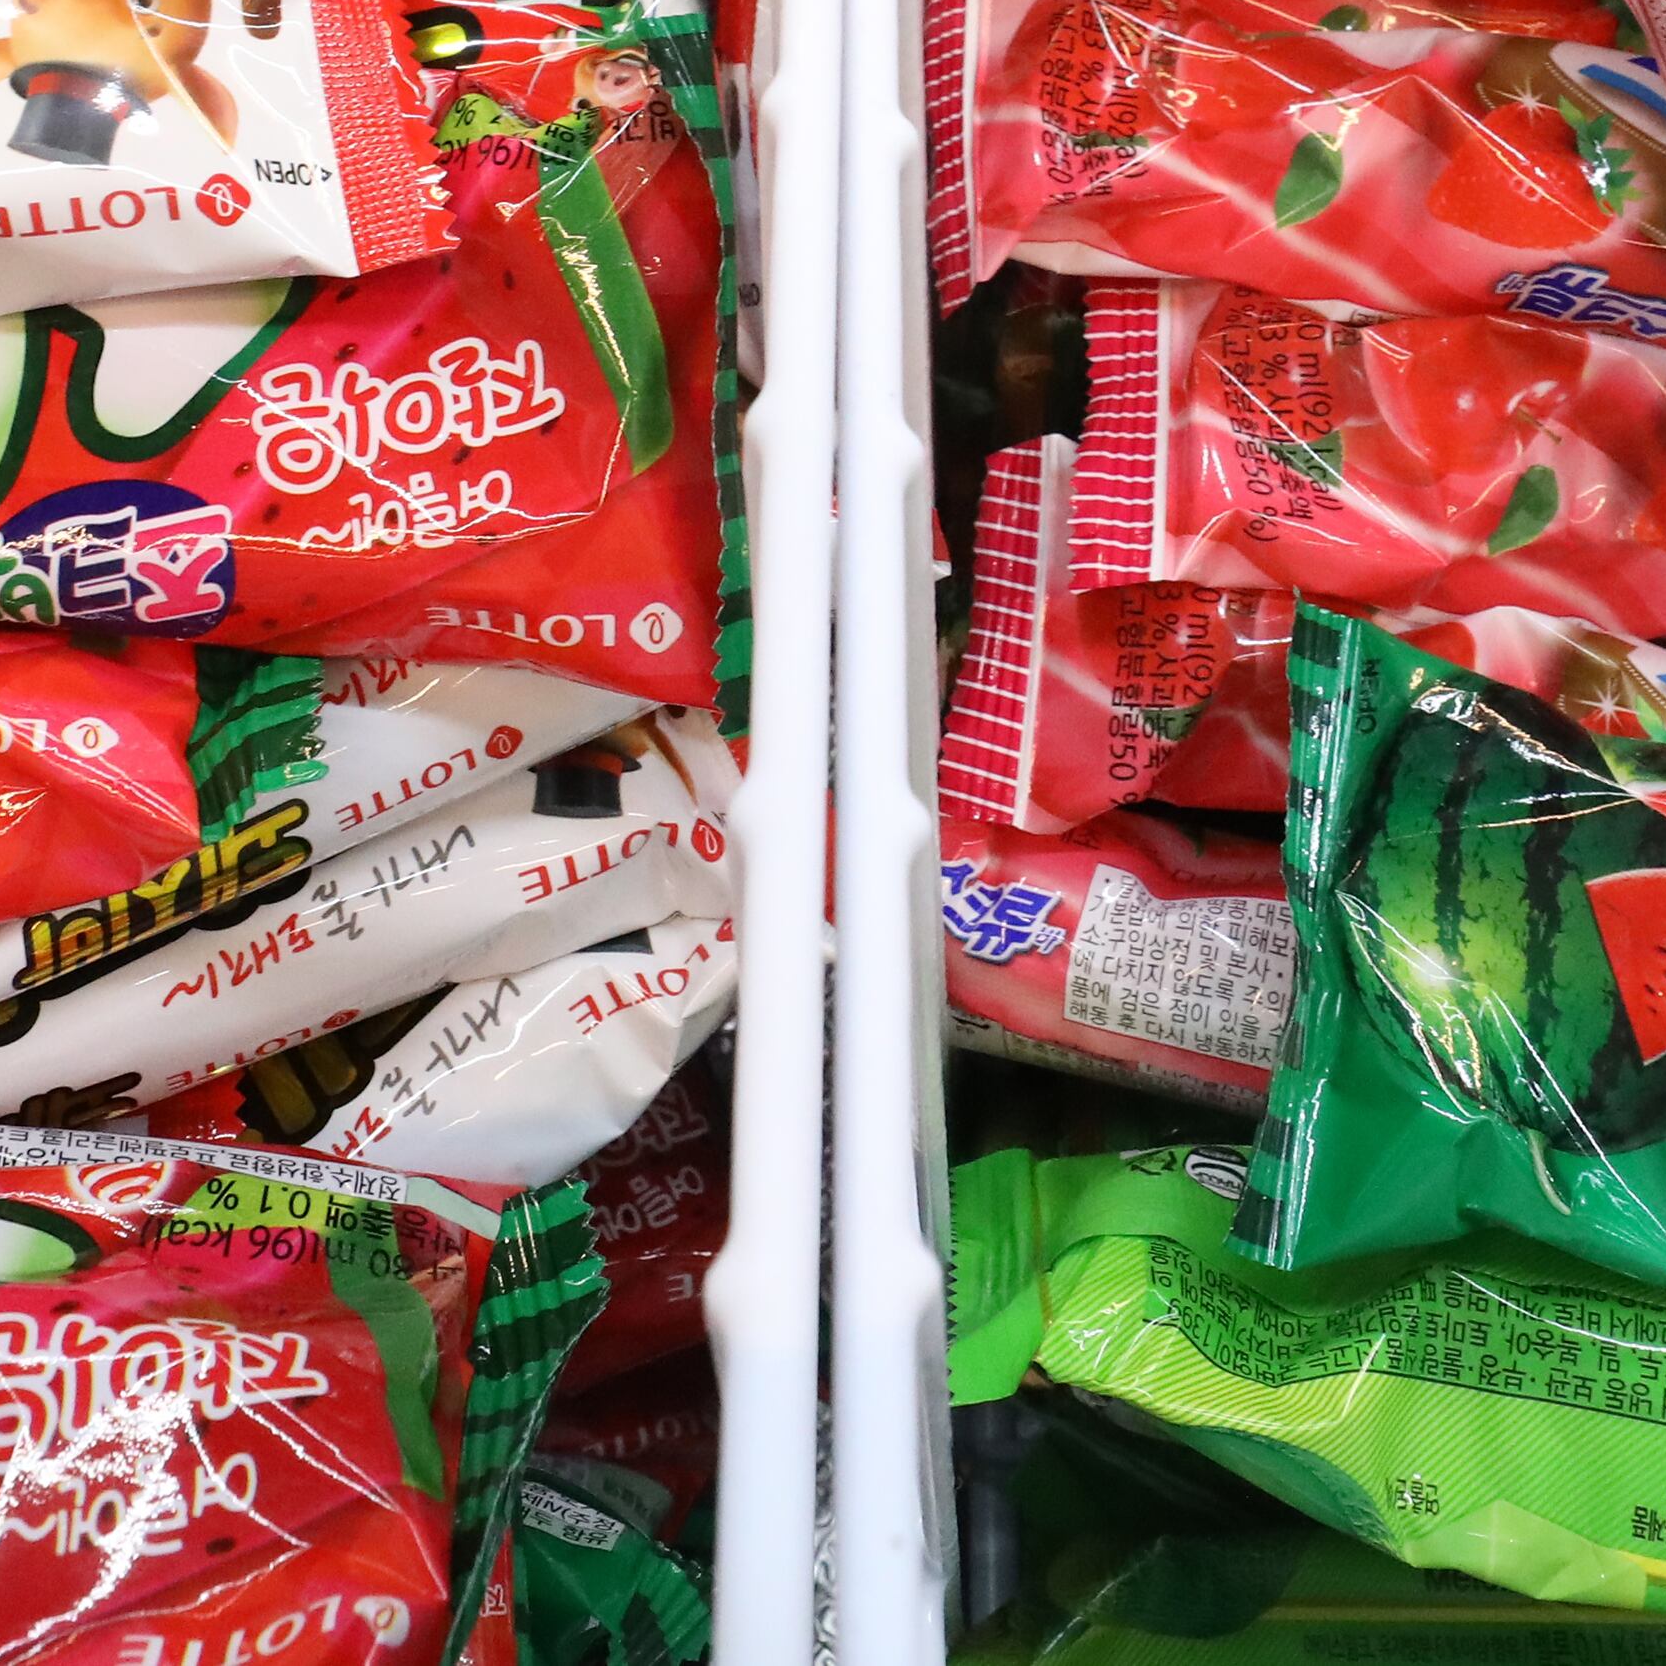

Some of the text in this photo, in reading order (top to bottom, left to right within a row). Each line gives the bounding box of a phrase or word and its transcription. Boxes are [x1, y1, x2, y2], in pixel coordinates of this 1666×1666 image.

[255, 339, 564, 494] 잘익은
[426, 606, 618, 650] LOTTE
[1182, 613, 1216, 700] ml(92
[334, 746, 478, 834] LOTTE
[517, 821, 680, 906] LOTTE
[568, 943, 711, 1036] LOTTE
[205, 1177, 313, 1222] 0.1 %
[1545, 1367, 1598, 1402] 보관
[1601, 1378, 1654, 1417] 냉동
